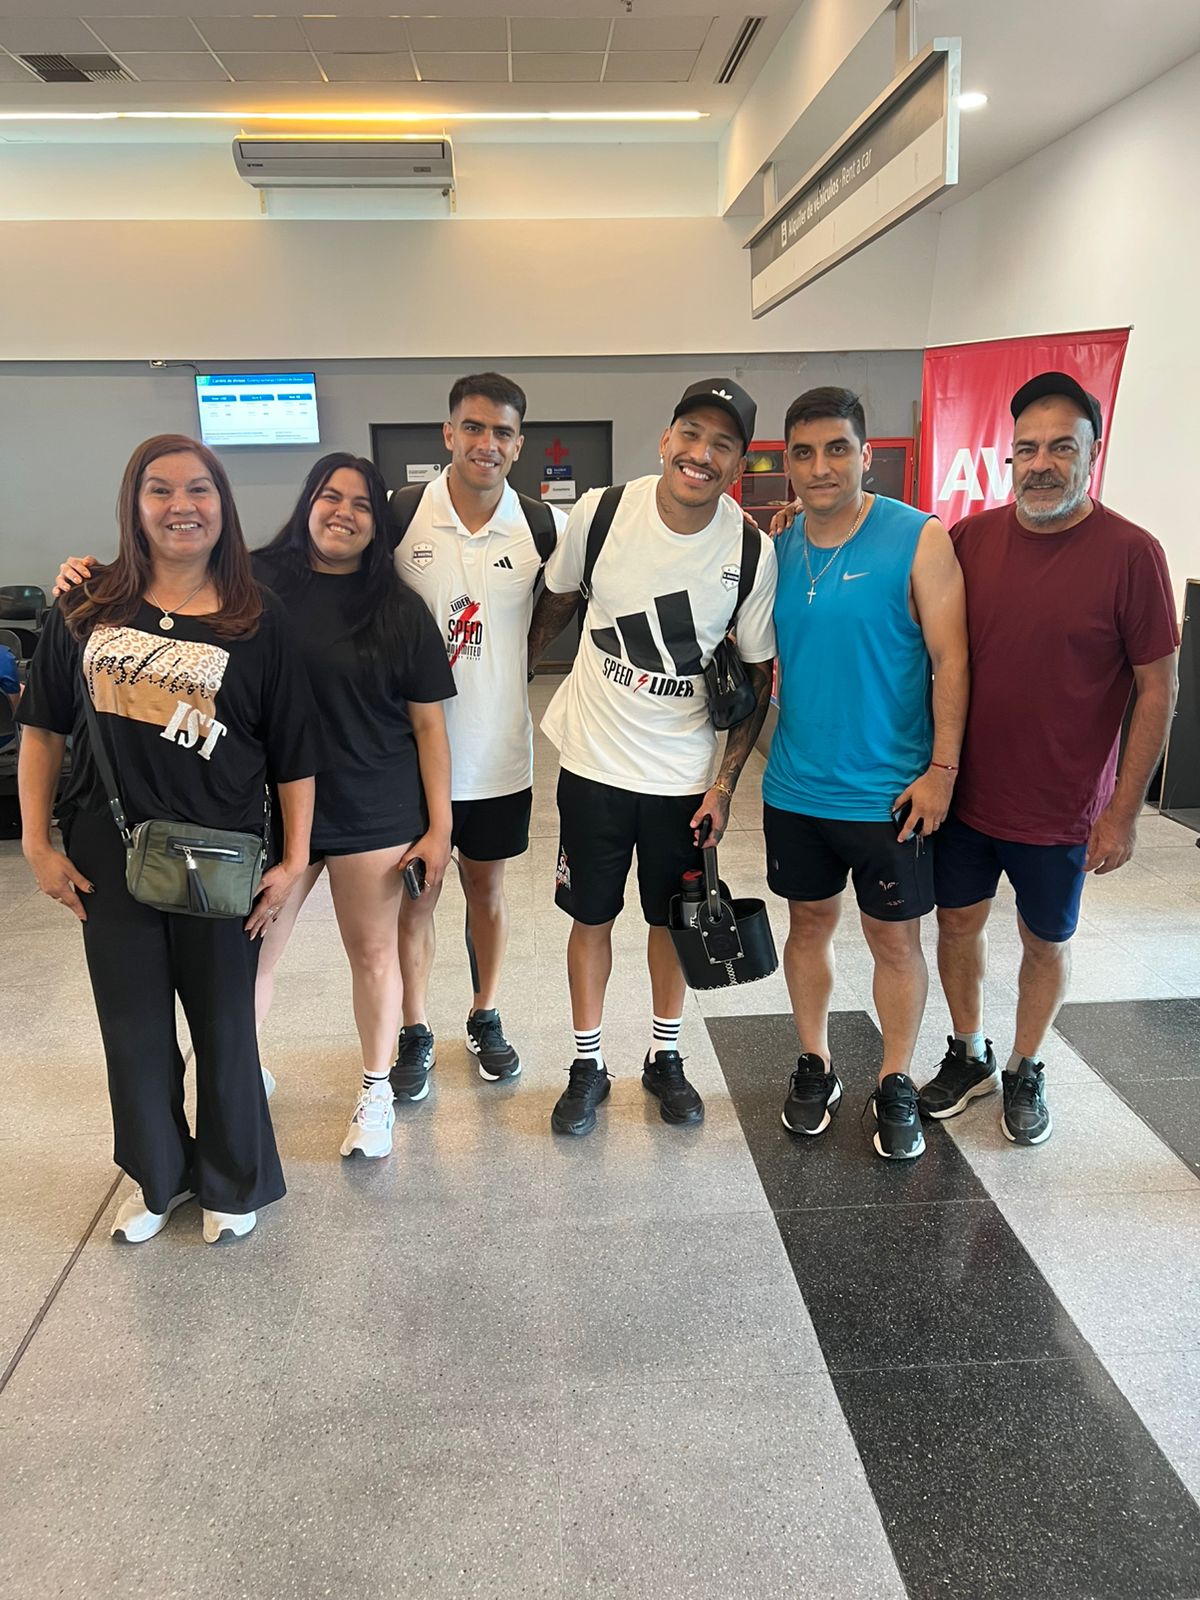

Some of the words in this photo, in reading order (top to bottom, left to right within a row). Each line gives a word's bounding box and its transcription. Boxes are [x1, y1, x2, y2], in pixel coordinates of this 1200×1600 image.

[788, 209, 807, 236] Alquiler
[807, 200, 813, 219] de
[841, 160, 856, 187] Rent
[856, 159, 861, 175] a
[861, 148, 872, 170] car
[450, 596, 472, 613] LIDER
[447, 618, 482, 645] SPEED
[602, 657, 634, 688] SPEED
[648, 676, 695, 698] LIDER
